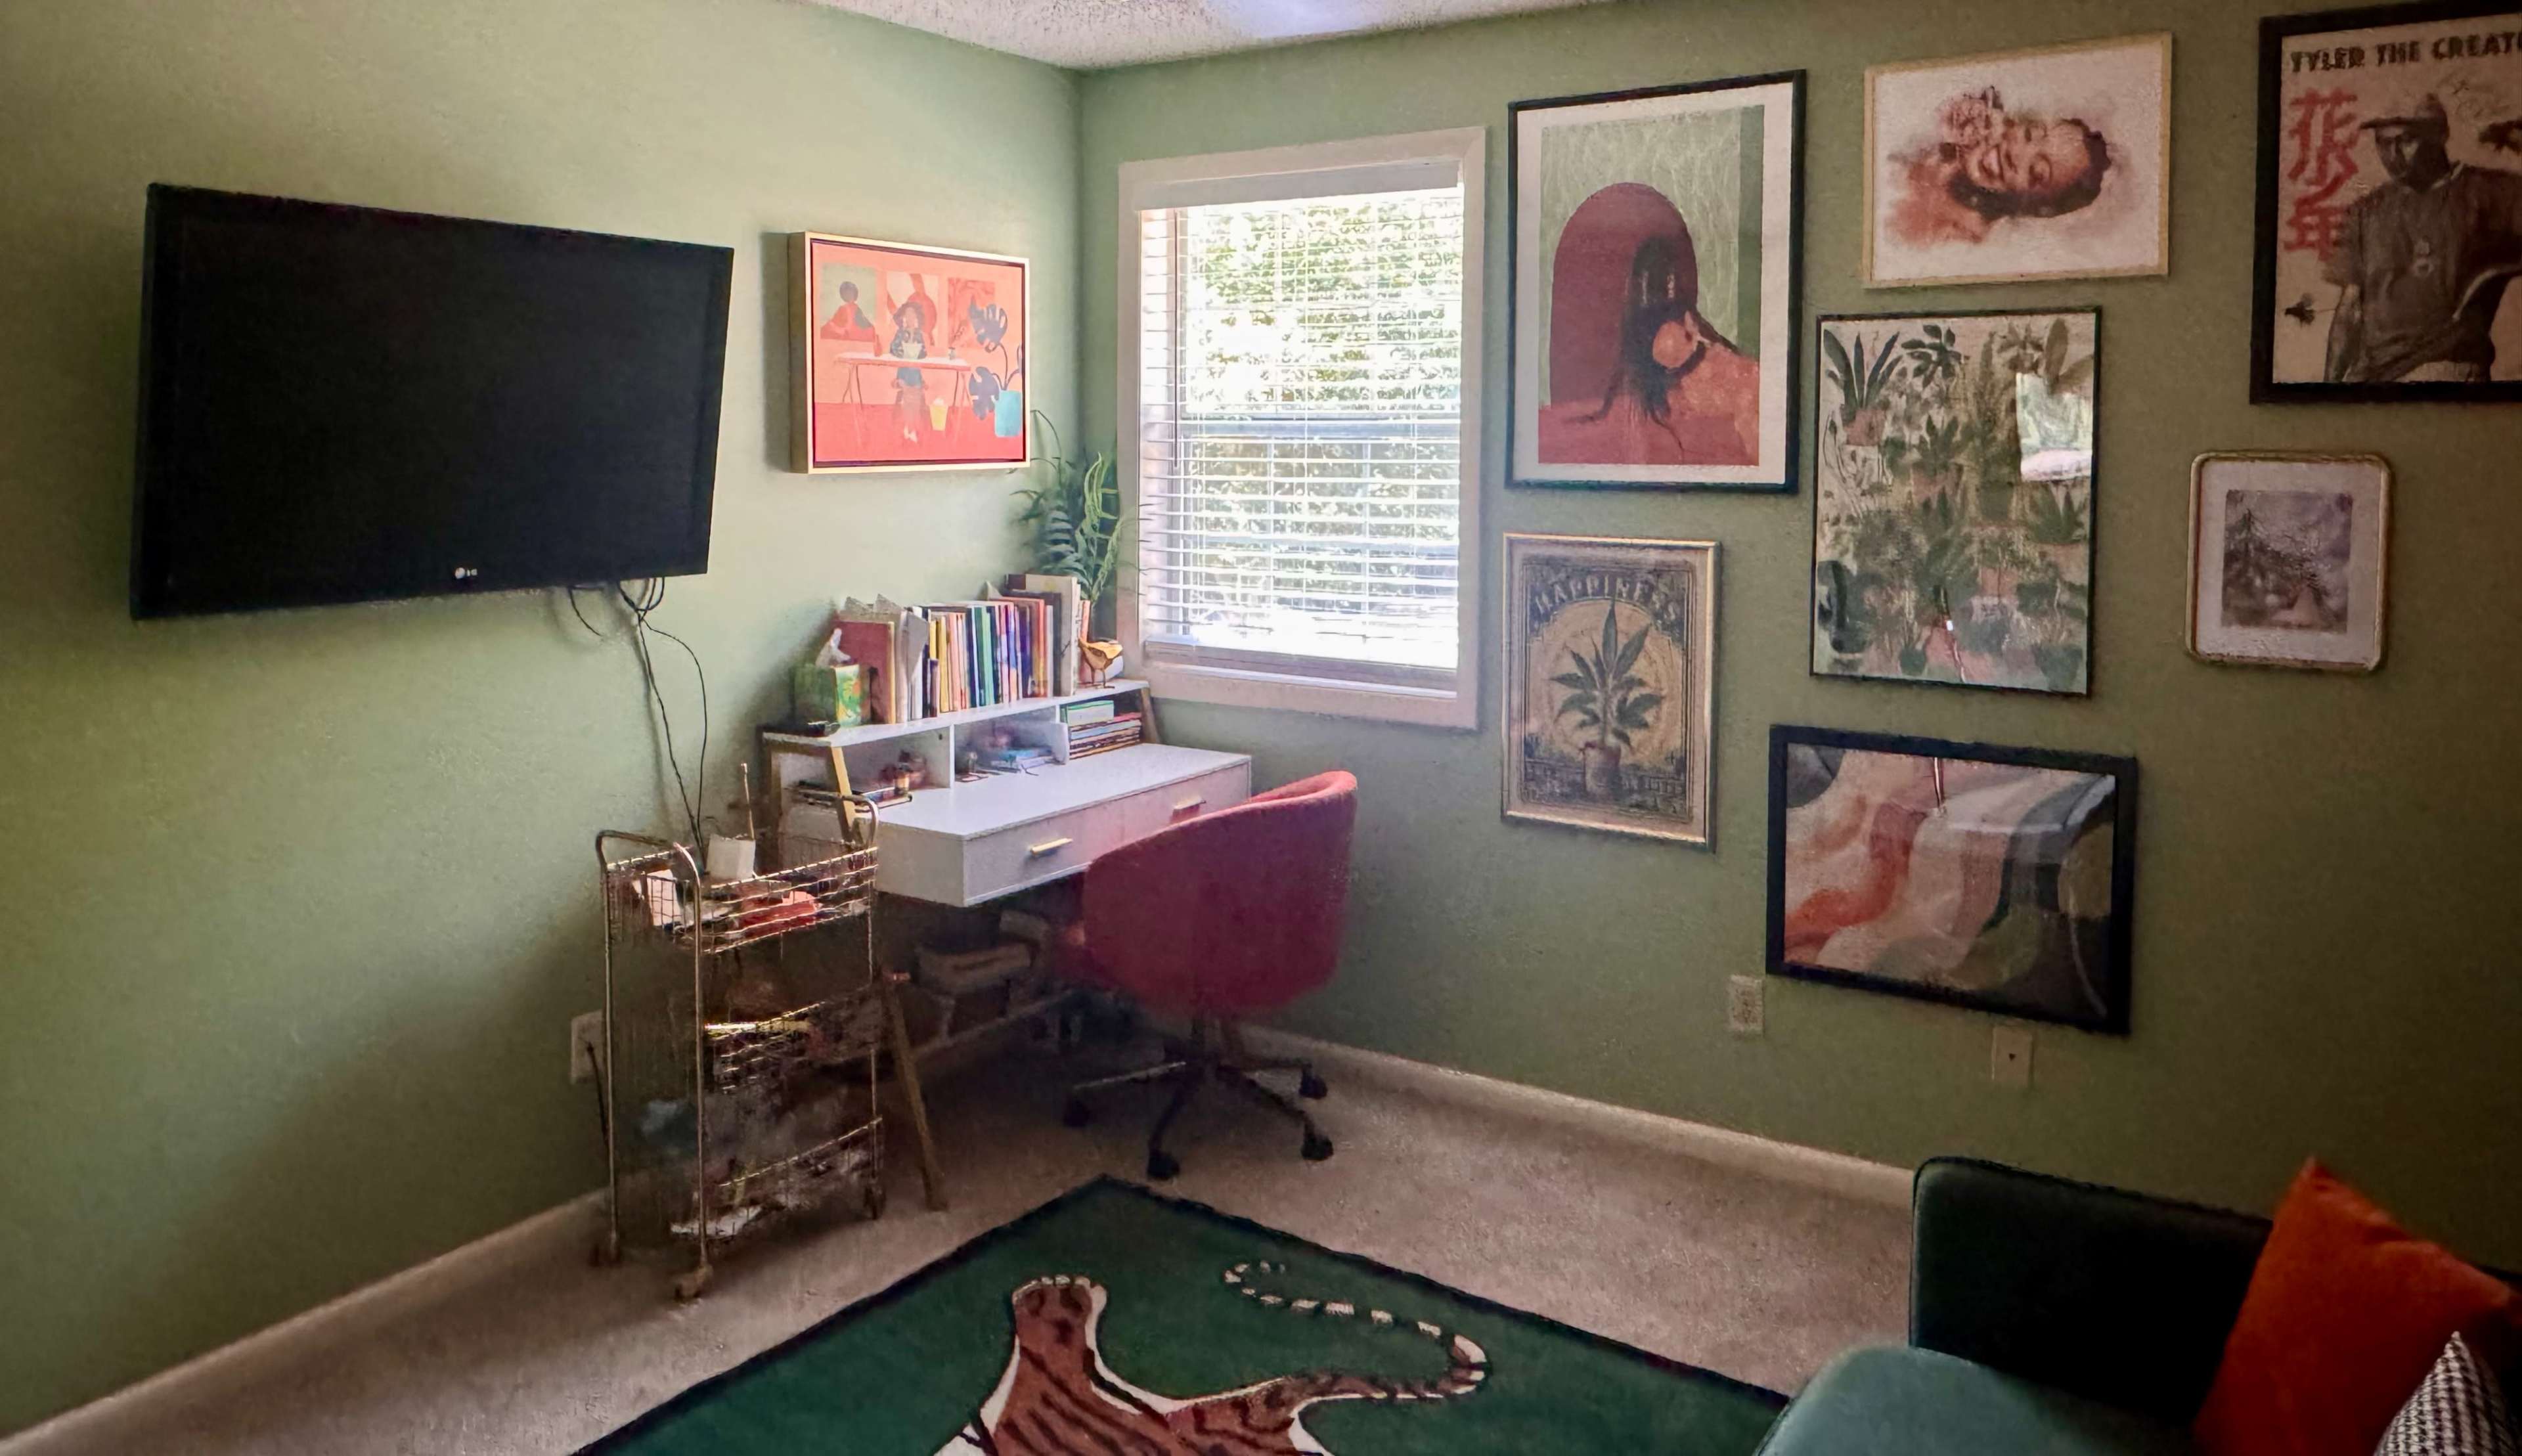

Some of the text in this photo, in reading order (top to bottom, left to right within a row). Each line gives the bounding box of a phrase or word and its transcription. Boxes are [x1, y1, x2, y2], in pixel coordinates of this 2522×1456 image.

[2290, 32, 2522, 72] TYLER THE CREAT
